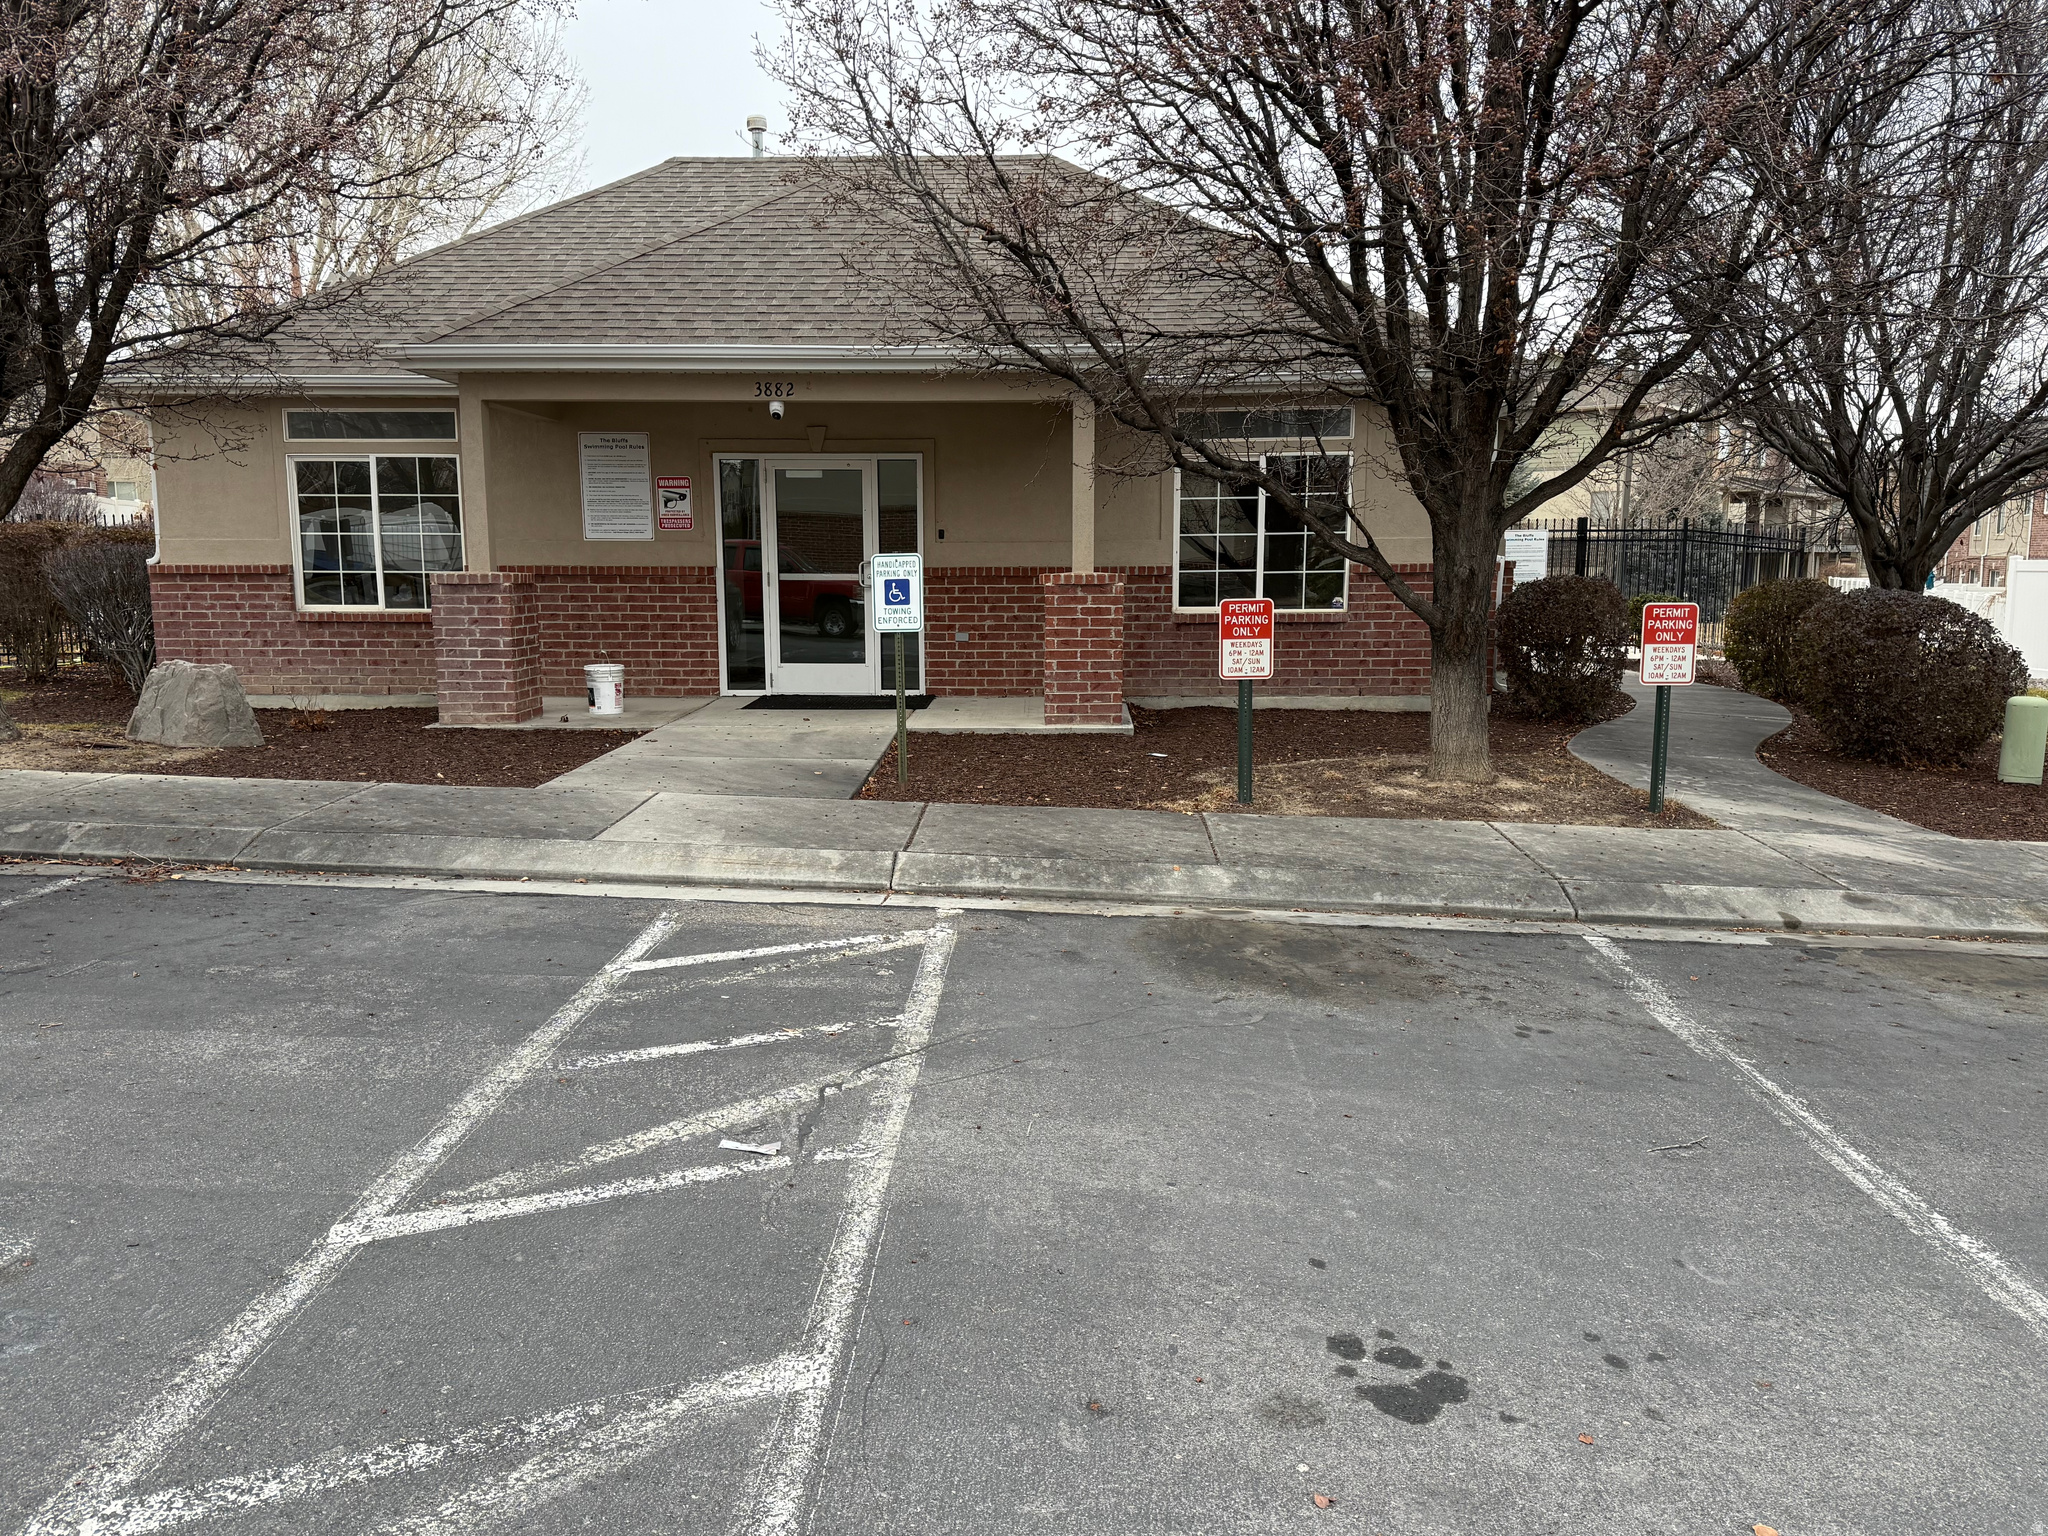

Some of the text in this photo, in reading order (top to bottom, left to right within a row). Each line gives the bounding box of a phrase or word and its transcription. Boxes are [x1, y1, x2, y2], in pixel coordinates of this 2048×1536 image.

[754, 381, 795, 397] 3882
[658, 479, 689, 487] WARNING
[877, 560, 917, 568] HANDICAPPED
[903, 569, 918, 577] ONLY
[1229, 603, 1265, 613] PERMIT
[1653, 608, 1691, 618] PERMIT
[877, 616, 919, 625] ENFORCED
[1224, 615, 1269, 625] PARKING
[1647, 620, 1693, 630] PARKING
[1232, 626, 1261, 636] ONLY
[1655, 631, 1685, 642] ONLY
